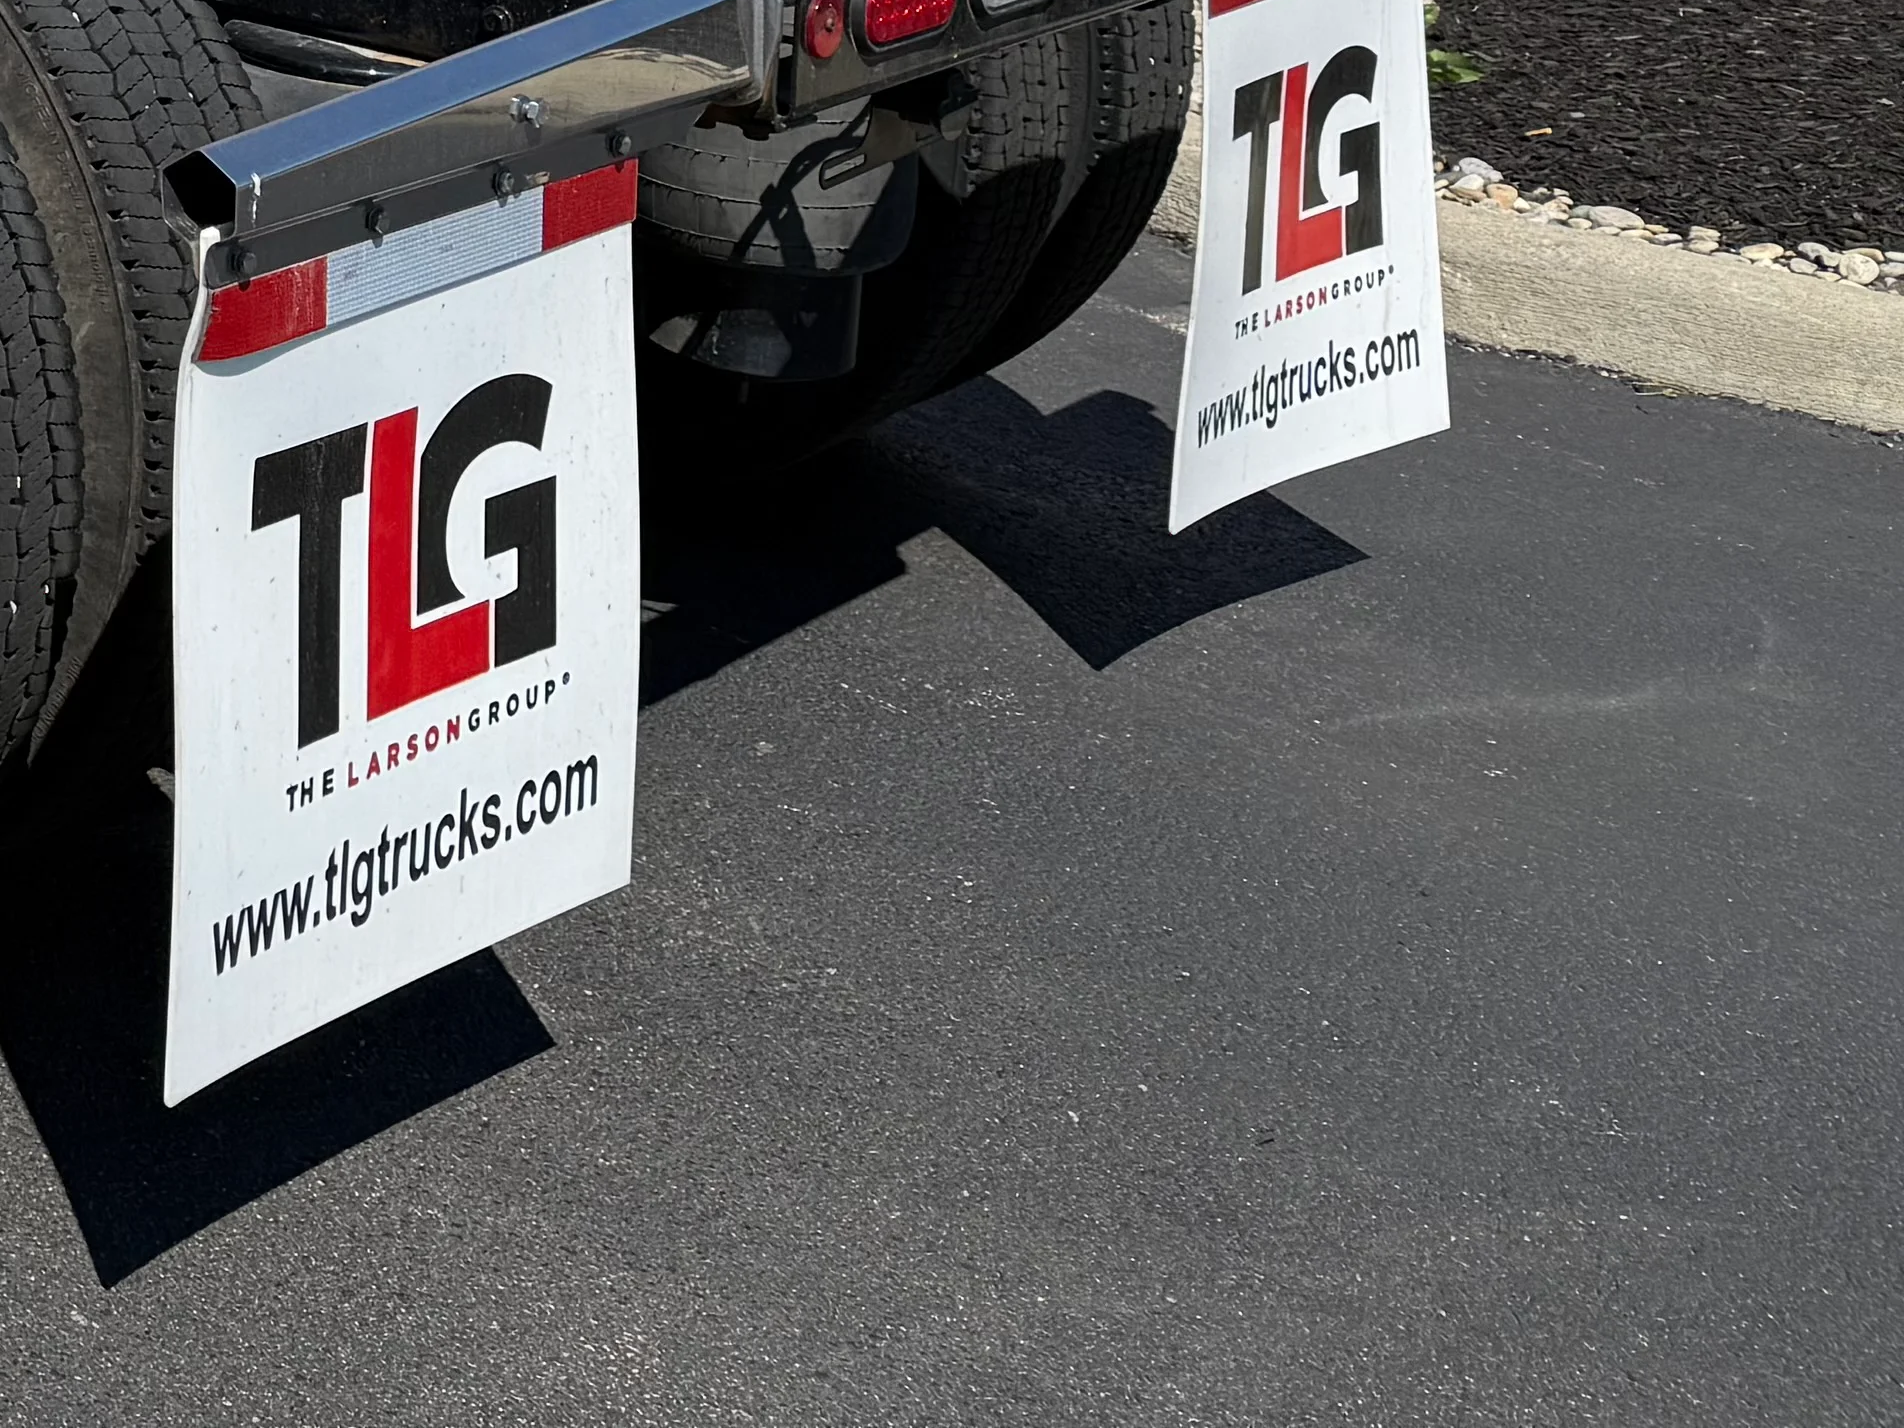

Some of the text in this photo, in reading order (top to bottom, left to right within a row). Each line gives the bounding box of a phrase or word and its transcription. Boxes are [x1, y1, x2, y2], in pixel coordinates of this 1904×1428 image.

[1231, 44, 1384, 297] TLG
[1196, 326, 1421, 449] www.tlgtrucks.com
[1234, 311, 1259, 340] THE
[249, 372, 559, 750] TLG
[211, 753, 599, 976] www.tlgtrucks.com
[285, 767, 335, 813] THE
